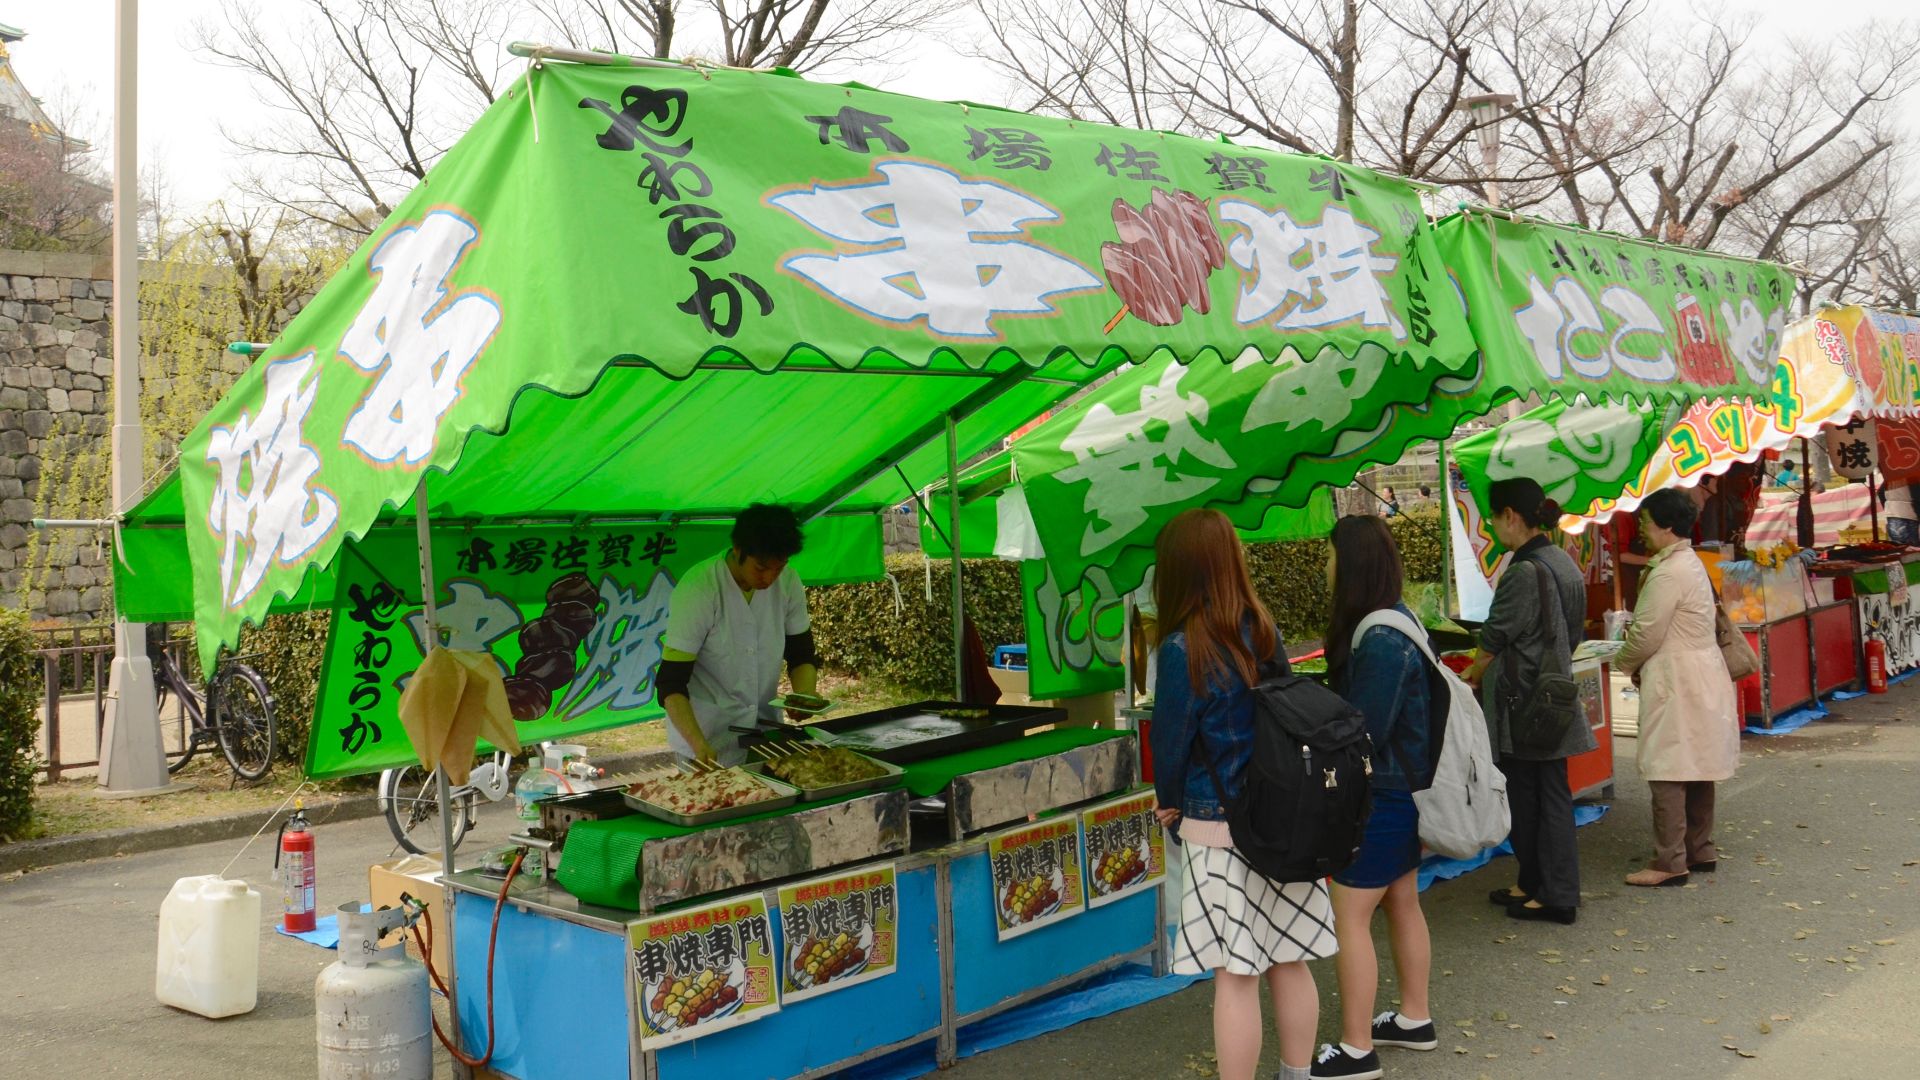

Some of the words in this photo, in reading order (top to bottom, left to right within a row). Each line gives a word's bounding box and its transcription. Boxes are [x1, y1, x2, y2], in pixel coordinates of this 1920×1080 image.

[804, 105, 1361, 201] 本場佐賀牛
[579, 84, 774, 338] やわらか
[1515, 273, 1677, 383] たこ
[457, 532, 678, 575] 本場佐賀牛
[338, 582, 405, 754] やわらか
[993, 832, 1078, 888] 串焼専門
[634, 914, 772, 986] 串焼専門
[783, 884, 896, 945] 串焼専門
